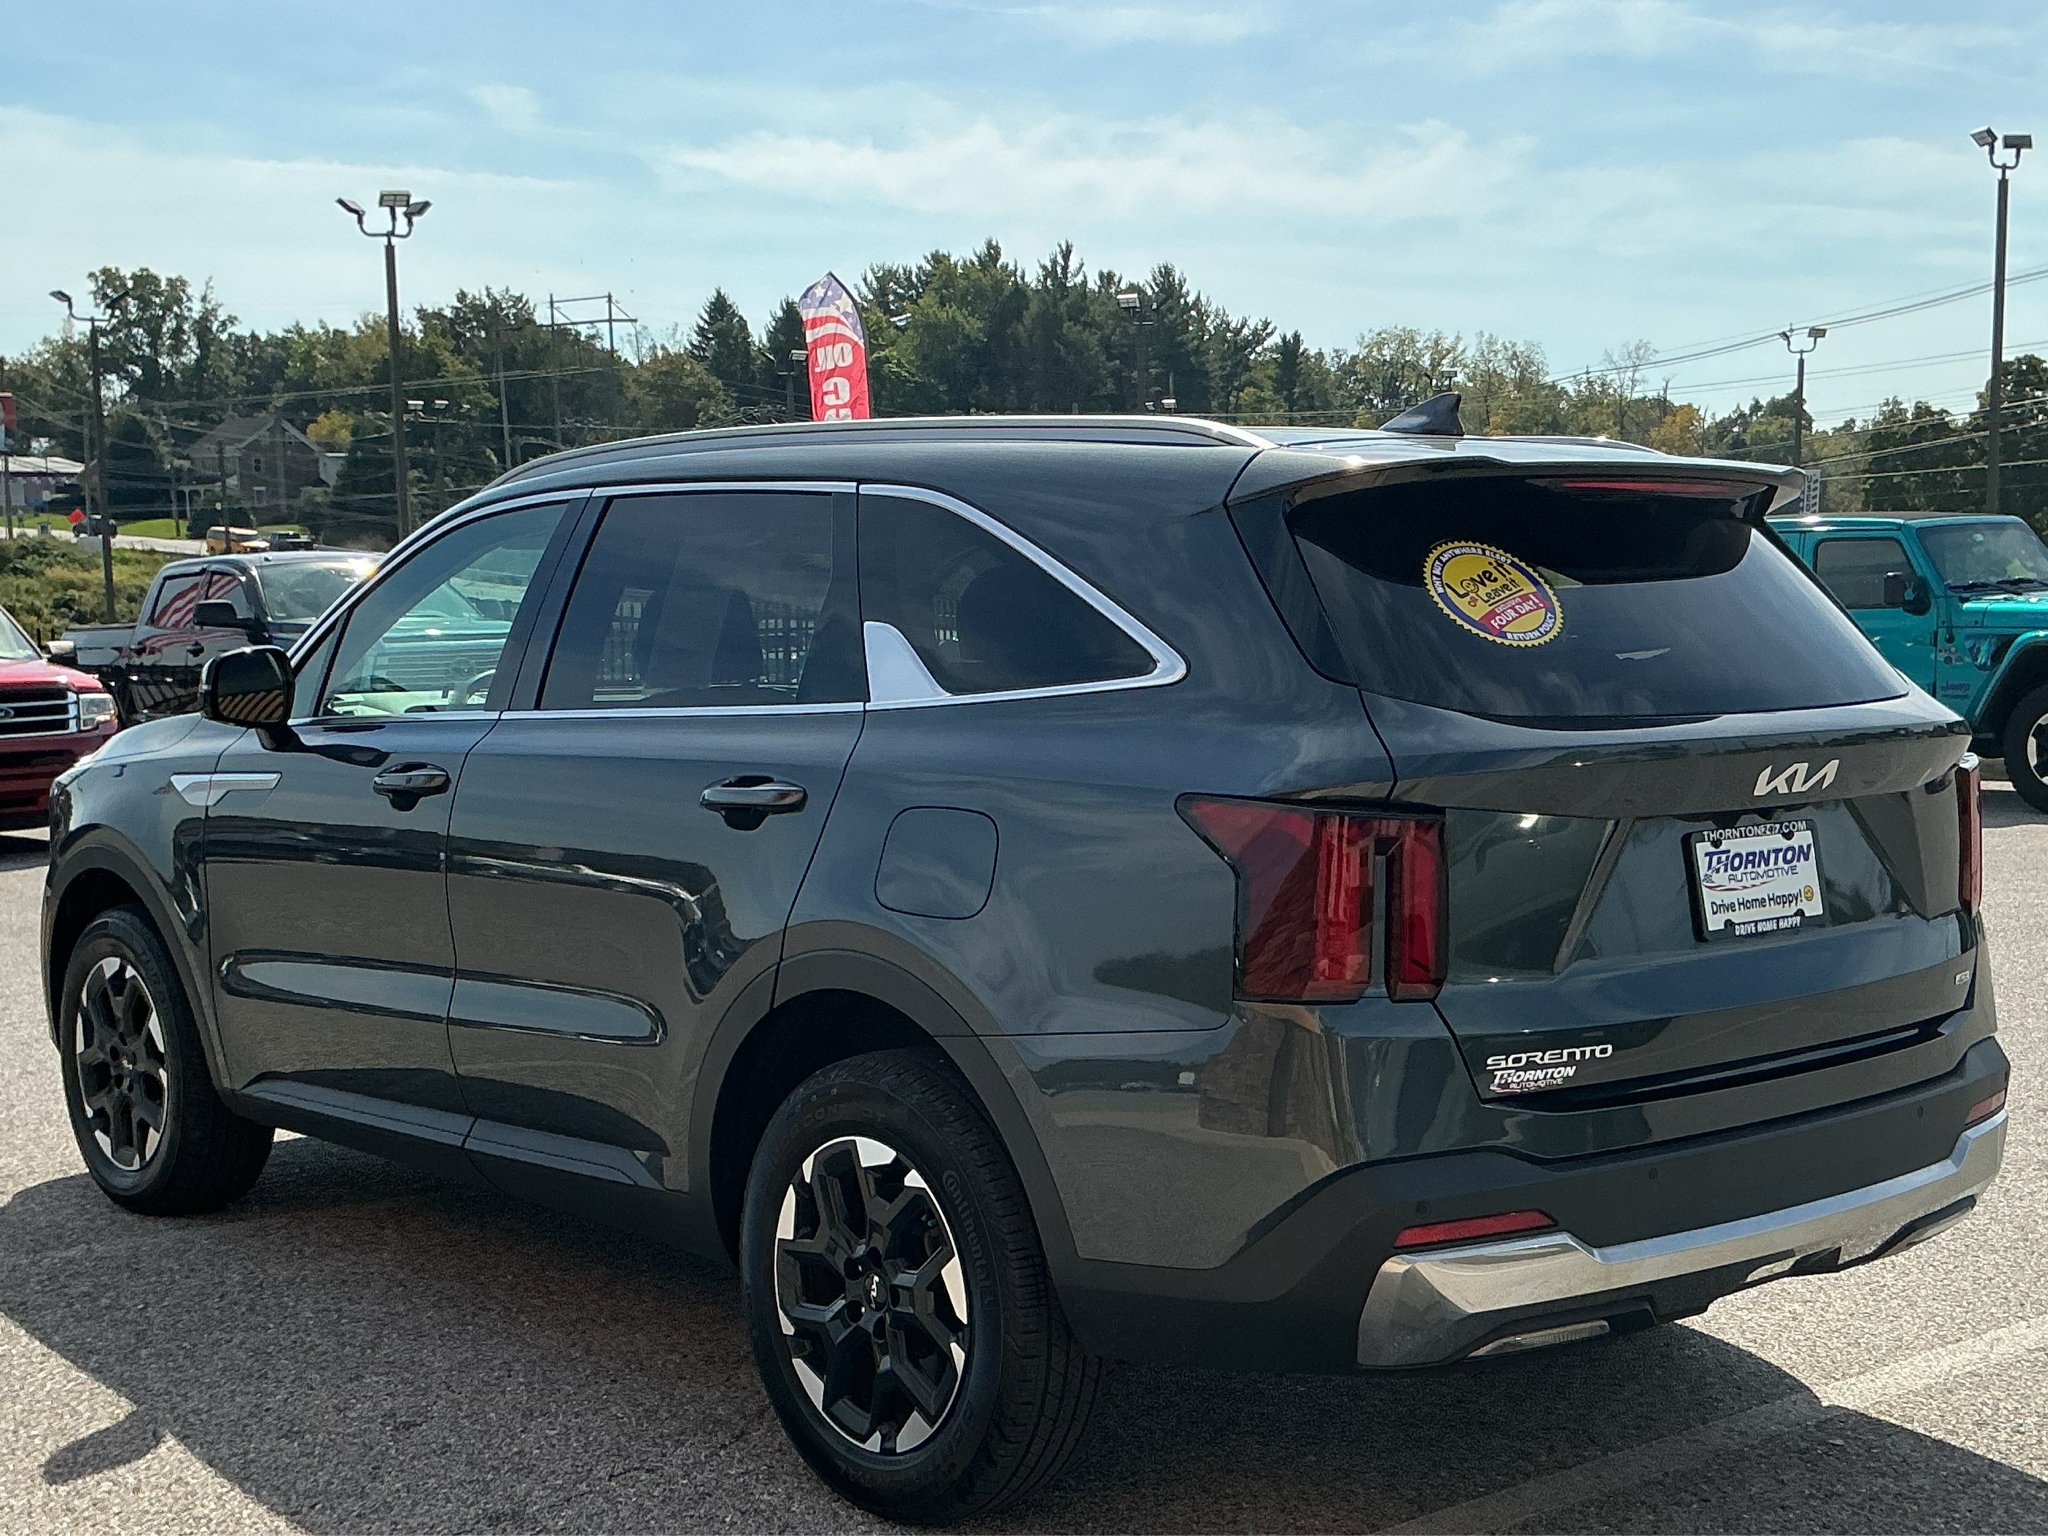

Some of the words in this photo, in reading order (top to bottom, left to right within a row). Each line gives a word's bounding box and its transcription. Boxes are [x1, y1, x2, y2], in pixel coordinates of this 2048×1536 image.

[1436, 561, 1444, 578] BUY
[1445, 570, 1499, 599] Love
[1488, 560, 1512, 578] it
[1433, 575, 1445, 594] WHY
[1477, 584, 1508, 604] Leave
[1506, 578, 1521, 590] it
[1490, 609, 1518, 630] FOUR
[1517, 594, 1544, 618] DAY!
[1505, 630, 1541, 641] RETURN
[1540, 612, 1556, 637] POLICY
[1704, 843, 1812, 875] THORNTON
[1728, 865, 1798, 884] AUTOMOTIVE
[1710, 899, 1737, 915] Drive
[1737, 894, 1767, 912] Home
[1768, 888, 1804, 909] Happy!
[1735, 922, 1757, 936] DRIVE
[1757, 919, 1778, 933] HOME
[1778, 915, 1801, 930] HAPPY
[1486, 1044, 1612, 1070] SORENTO
[1493, 1065, 1577, 1085] THORNTON
[1509, 1078, 1563, 1089] AUTOMOTIVE
